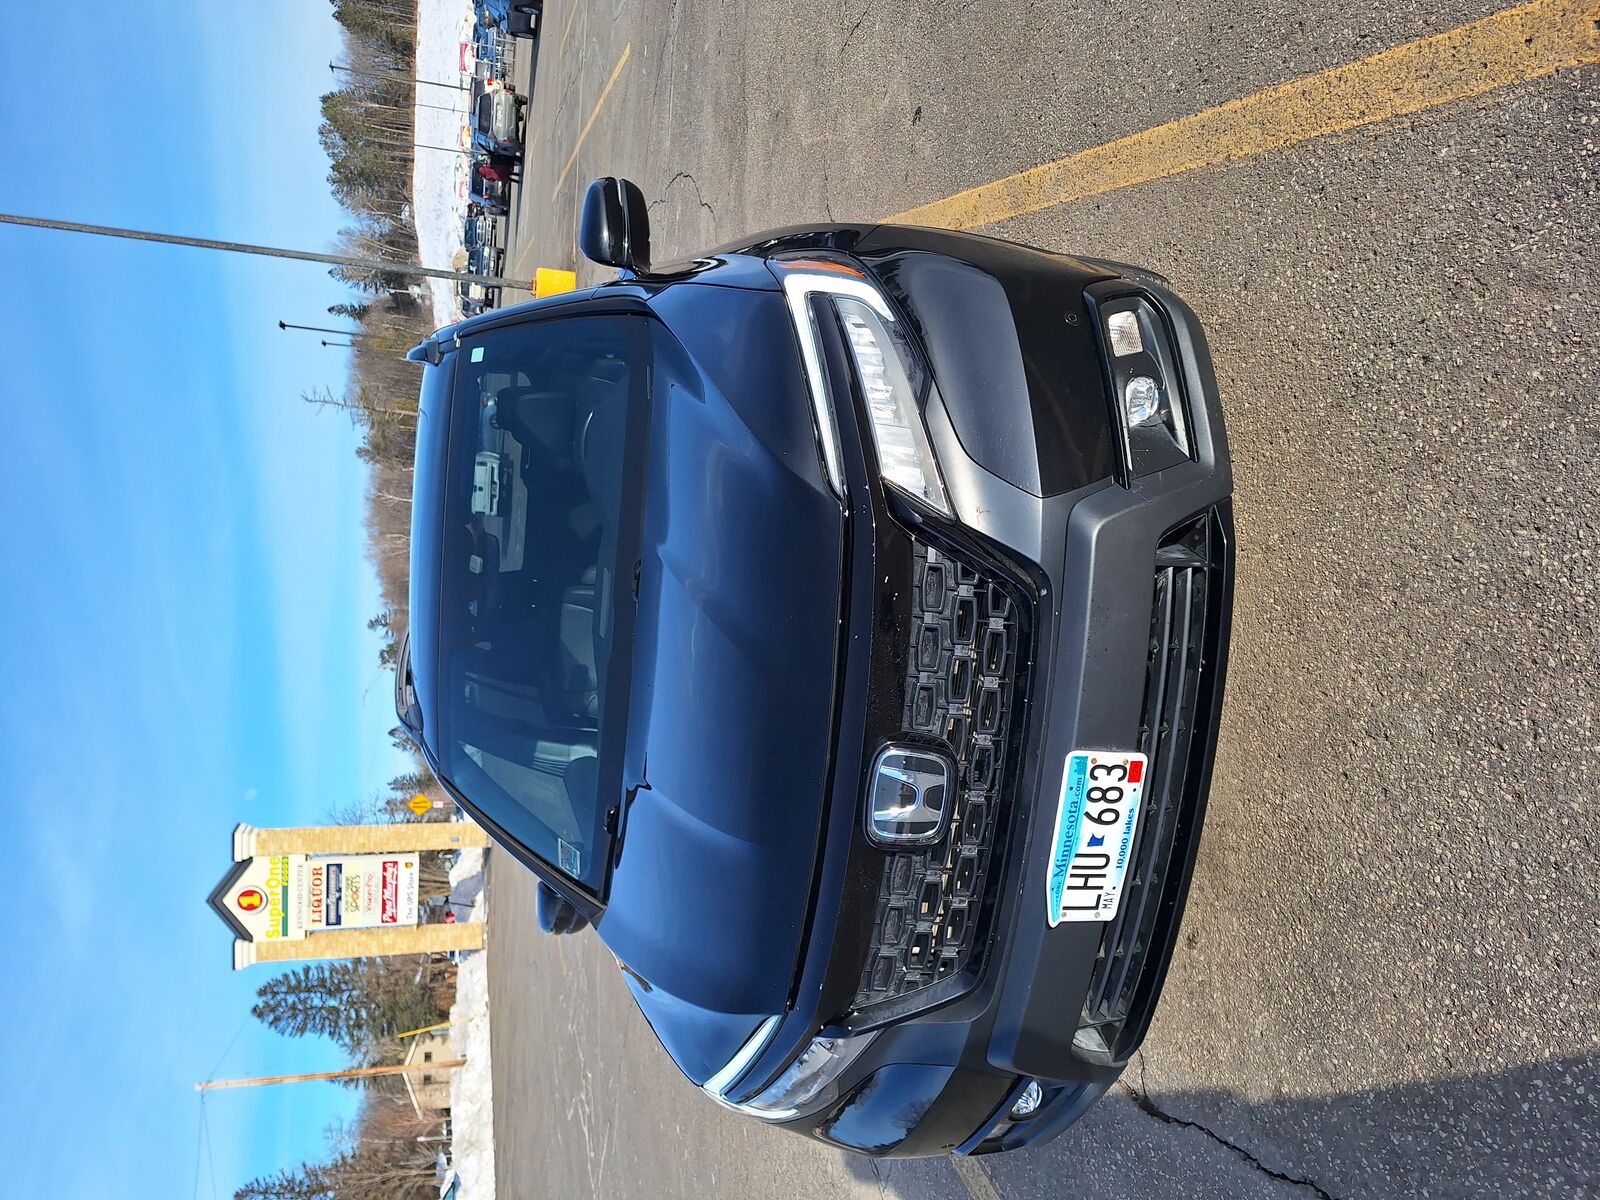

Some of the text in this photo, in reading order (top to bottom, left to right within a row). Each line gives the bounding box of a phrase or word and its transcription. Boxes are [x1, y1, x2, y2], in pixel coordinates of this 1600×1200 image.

[1062, 764, 1128, 911] LHU 683
[1116, 808, 1134, 869] 10,000 lakes
[239, 893, 260, 908] 1
[311, 866, 322, 923] LIQUOR
[350, 874, 360, 912] SPORTS
[406, 891, 414, 906] UPS
[1102, 892, 1116, 909] MAY
[382, 900, 396, 922] Papa
